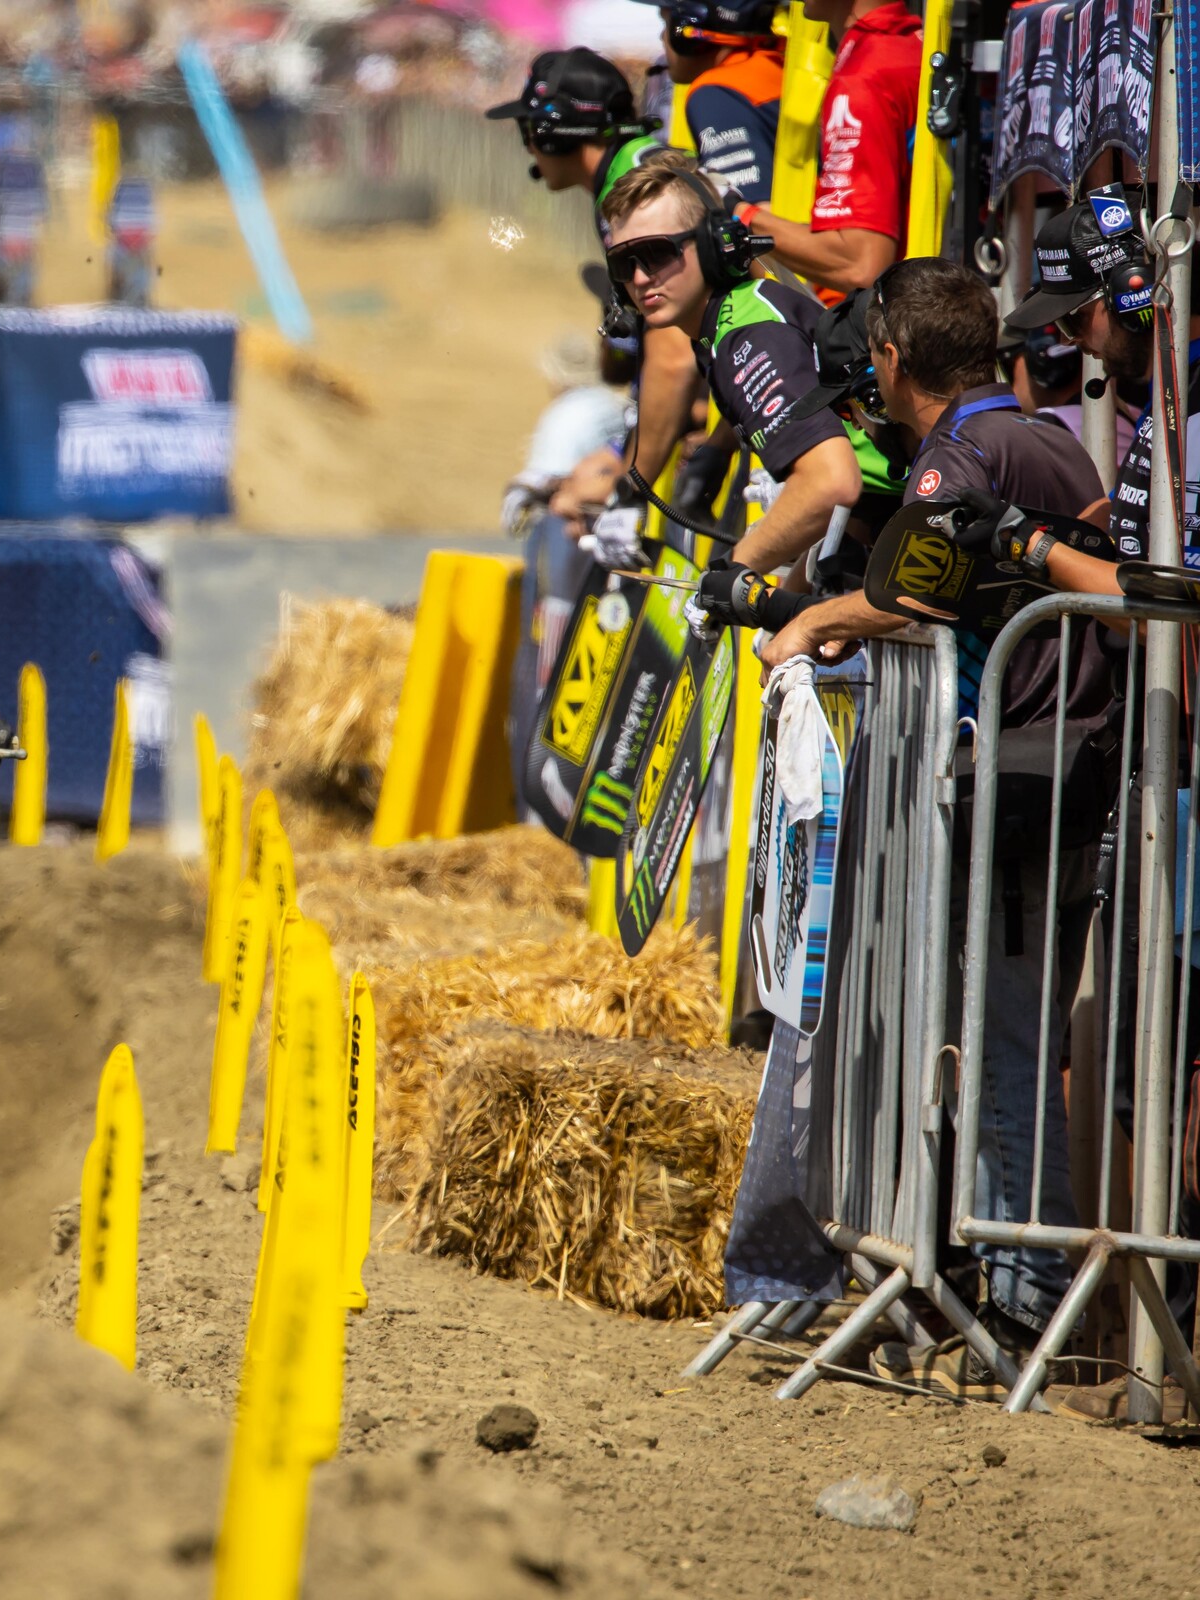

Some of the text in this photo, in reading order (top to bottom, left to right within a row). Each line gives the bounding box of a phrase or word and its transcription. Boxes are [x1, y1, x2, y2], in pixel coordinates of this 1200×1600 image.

[1040, 248, 1070, 260] YAMAHA
[1129, 288, 1152, 303] YAMA
[1118, 483, 1148, 506] THOR
[348, 1013, 362, 1131] ACERBIS
